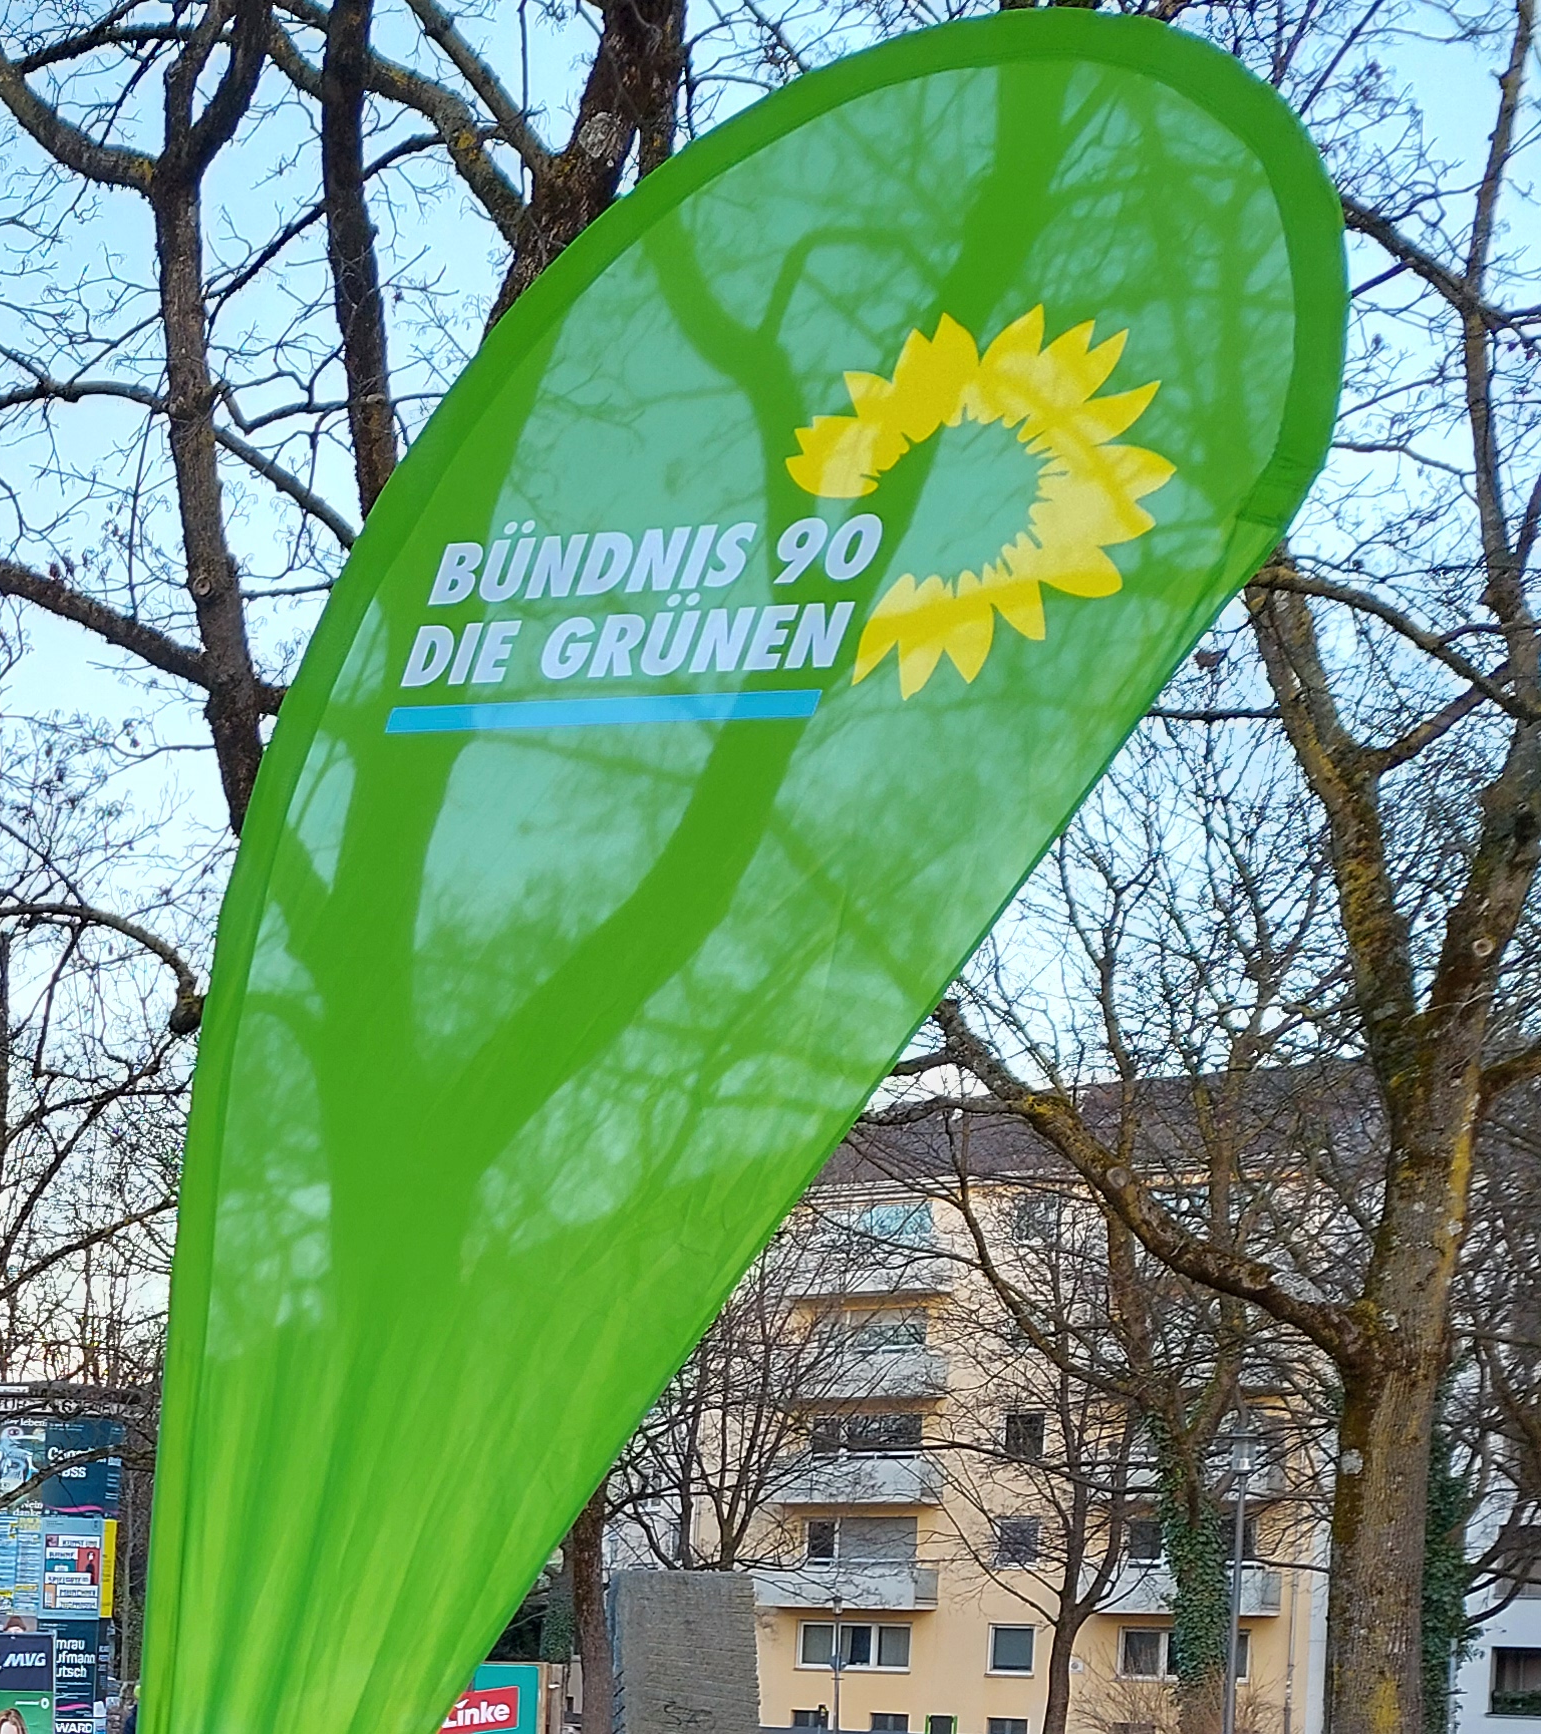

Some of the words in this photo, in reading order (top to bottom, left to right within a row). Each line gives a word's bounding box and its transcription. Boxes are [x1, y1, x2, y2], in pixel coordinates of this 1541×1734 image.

[427, 519, 758, 607] BÜNDNIS
[773, 512, 884, 586] 90
[400, 620, 522, 688] DIE
[539, 592, 856, 680] GRÜNEN
[55, 1639, 86, 1650] mrau
[2, 1652, 47, 1668] MVG
[55, 1650, 96, 1664] ufmann
[55, 1664, 88, 1678] utsch
[54, 1722, 93, 1734] WARD
